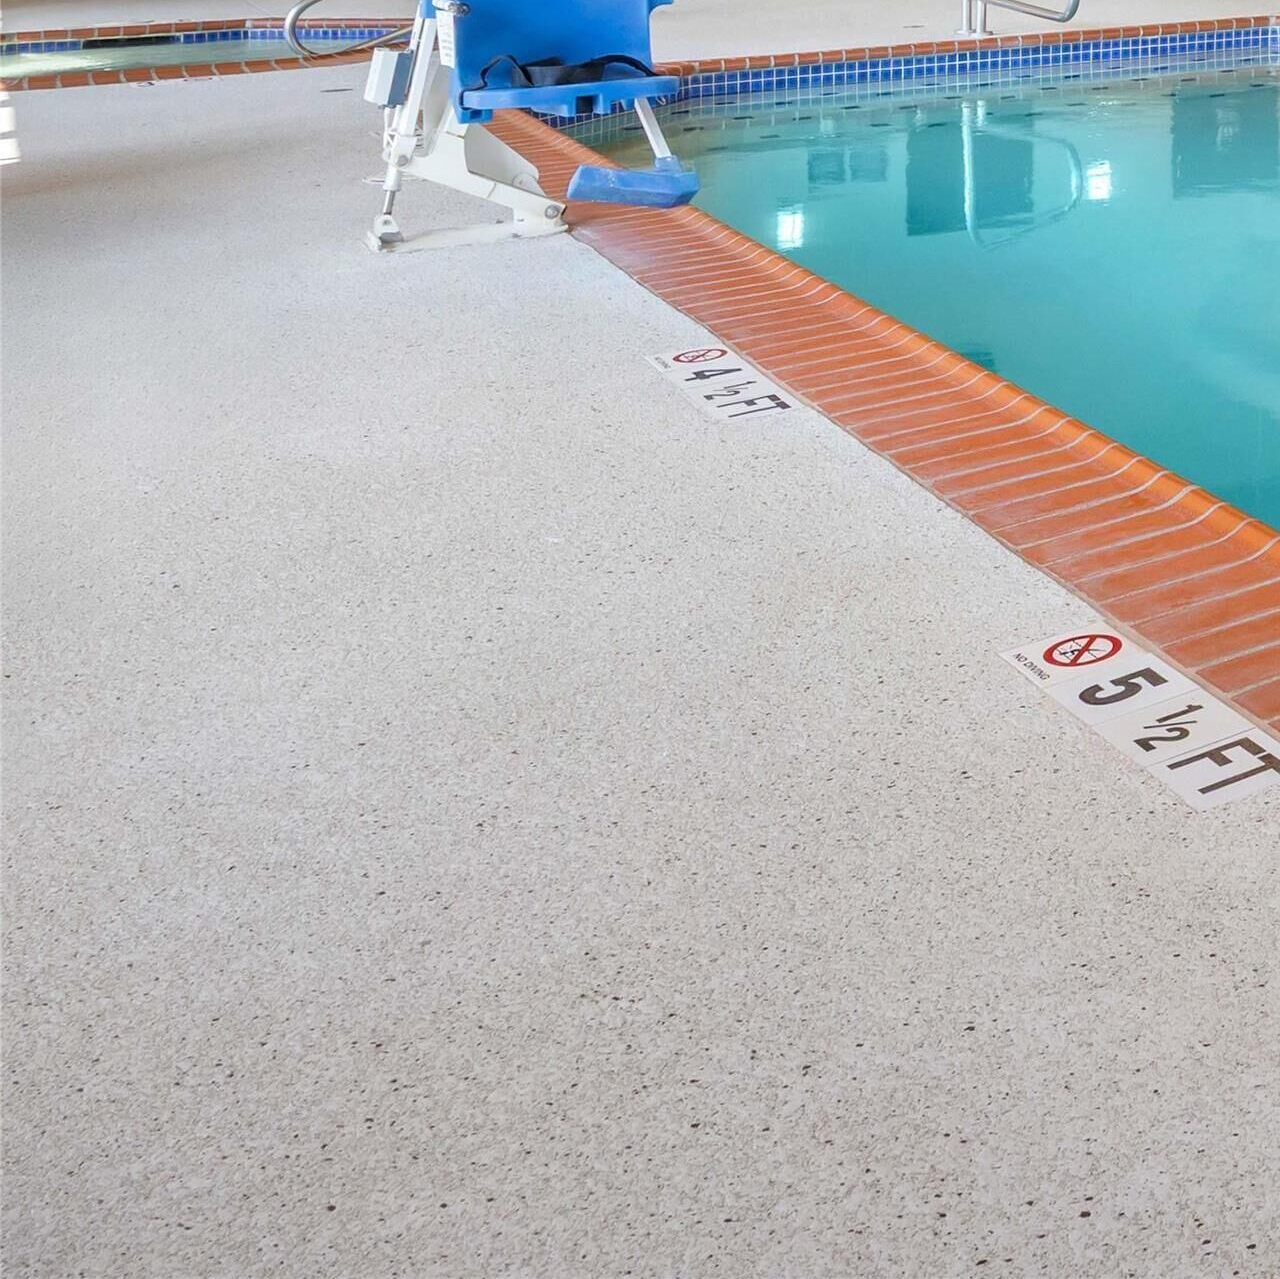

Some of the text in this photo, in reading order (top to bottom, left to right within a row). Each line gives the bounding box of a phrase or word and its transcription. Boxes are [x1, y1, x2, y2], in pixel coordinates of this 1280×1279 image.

[683, 367, 743, 382] 4
[715, 393, 792, 418] FT
[1023, 661, 1051, 680] DIVING
[1077, 666, 1169, 706] 5
